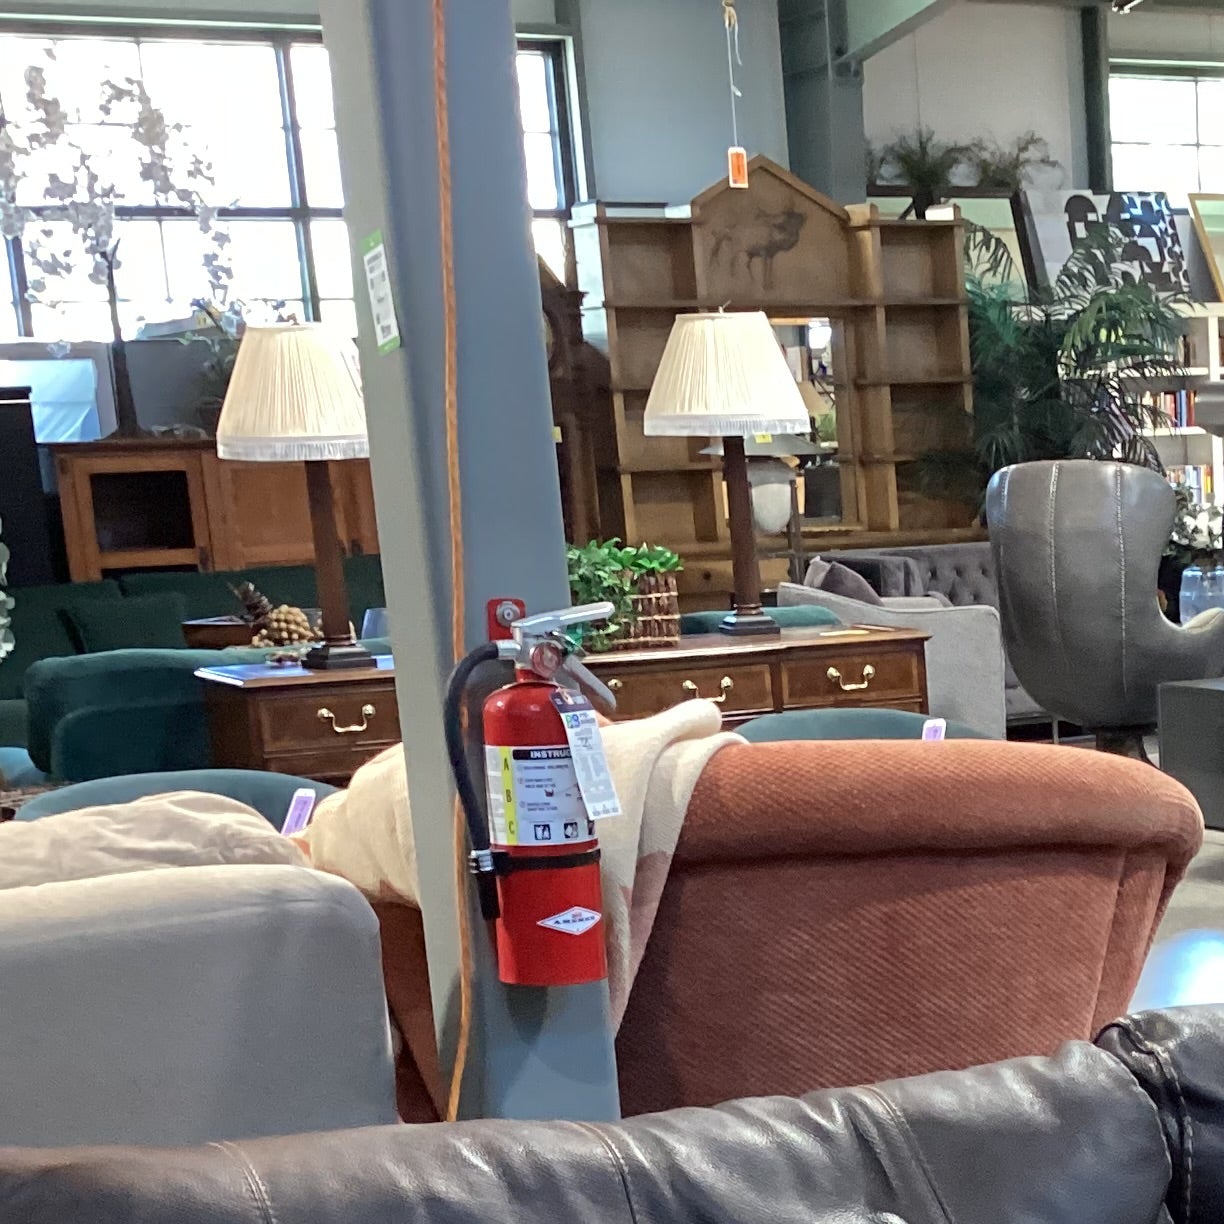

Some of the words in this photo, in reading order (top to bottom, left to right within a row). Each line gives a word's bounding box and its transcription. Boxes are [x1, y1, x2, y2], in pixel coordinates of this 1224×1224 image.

[503, 758, 510, 771] A
[505, 789, 512, 803] B
[508, 820, 515, 834] C
